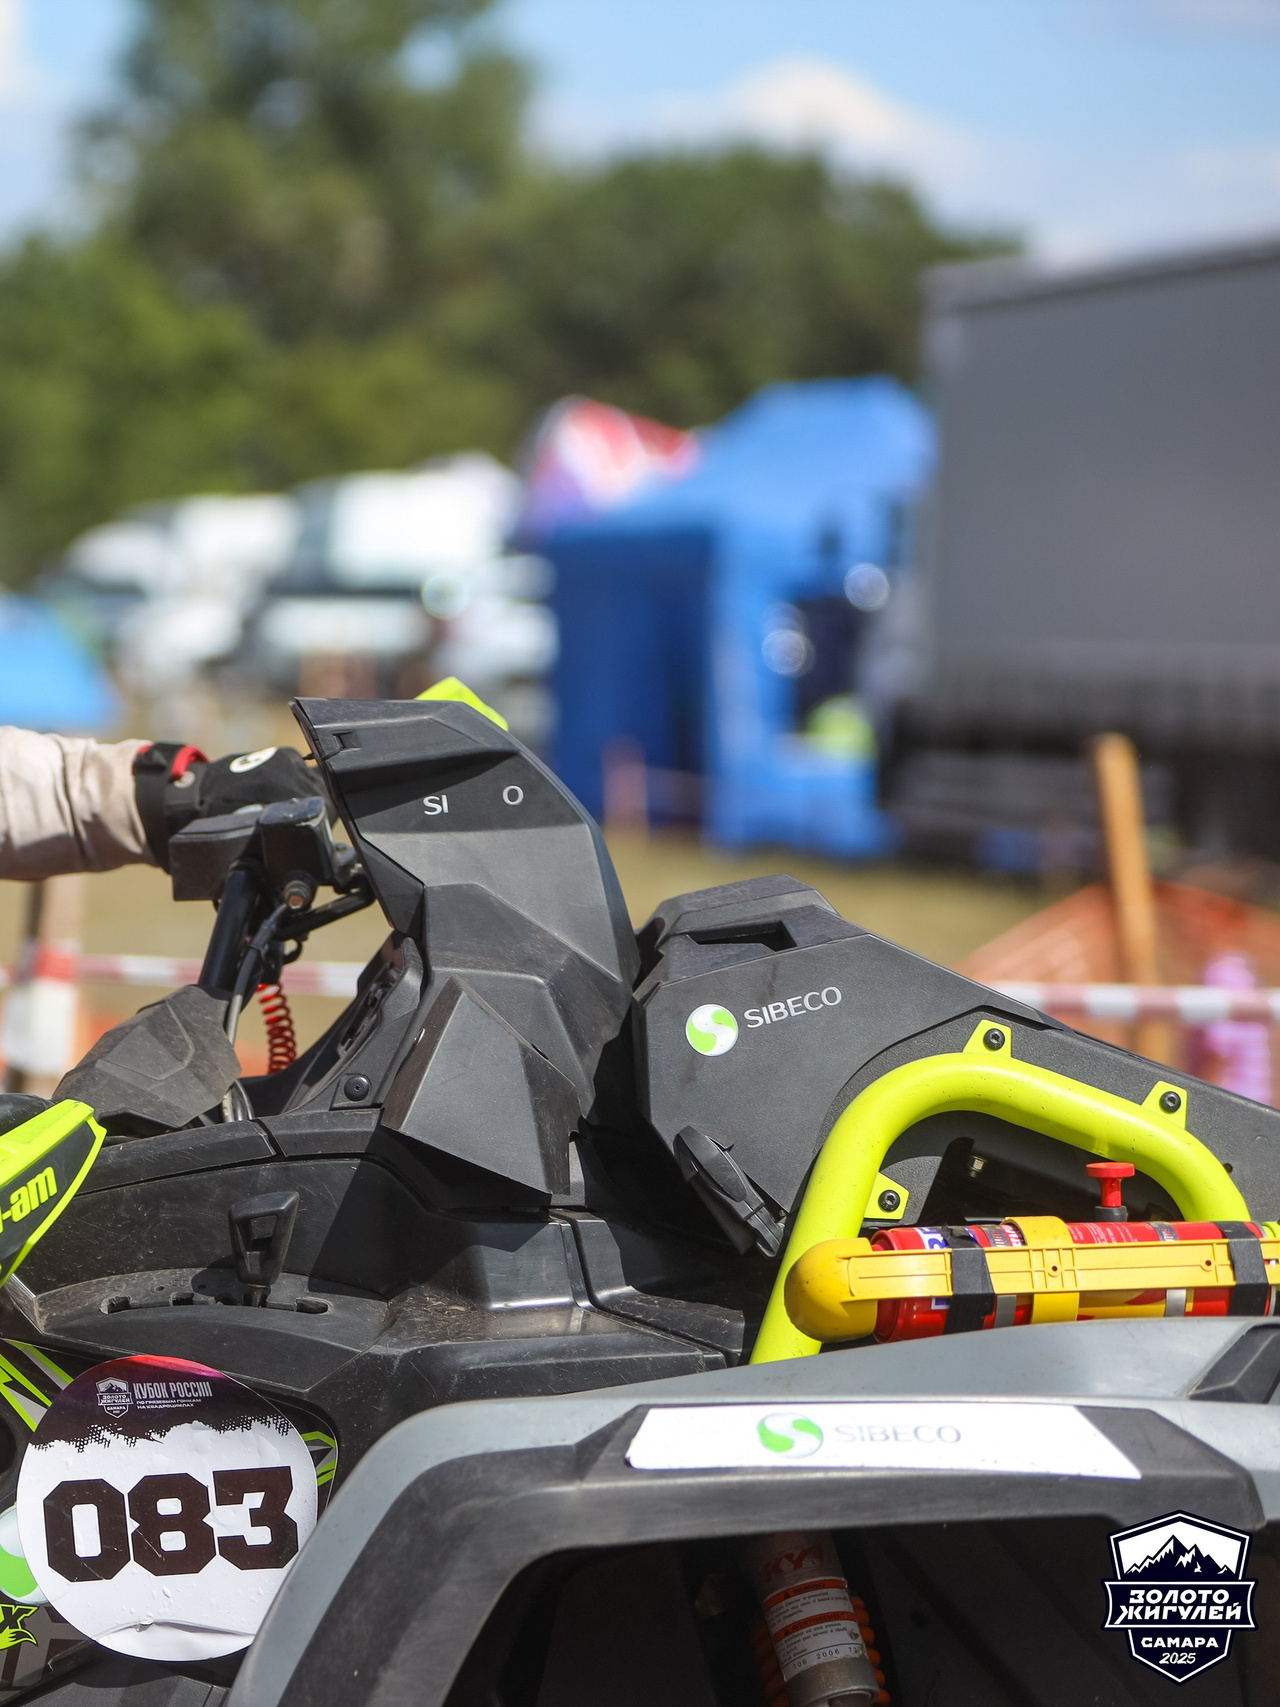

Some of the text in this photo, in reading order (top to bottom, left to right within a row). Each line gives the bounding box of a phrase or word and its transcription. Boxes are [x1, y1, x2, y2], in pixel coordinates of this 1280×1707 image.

[743, 986, 842, 1029] SIBECO
[133, 1381, 213, 1400] КУБОК РОССИИ
[834, 1424, 962, 1444] SIBECO
[43, 1466, 299, 1583] 083
